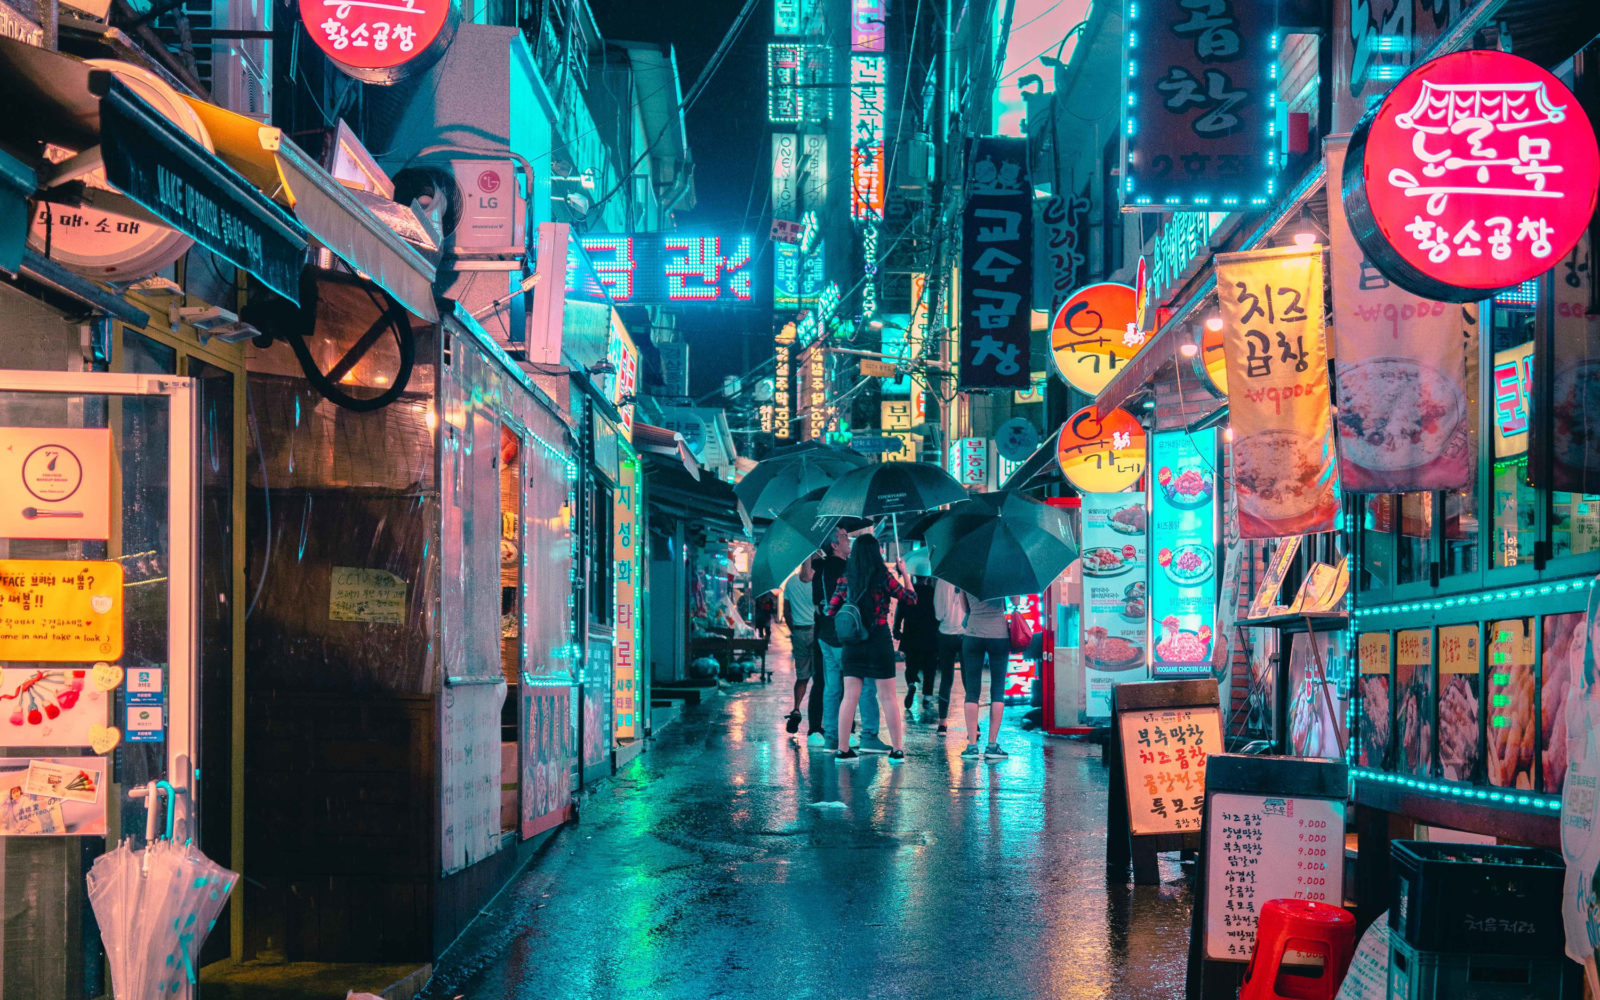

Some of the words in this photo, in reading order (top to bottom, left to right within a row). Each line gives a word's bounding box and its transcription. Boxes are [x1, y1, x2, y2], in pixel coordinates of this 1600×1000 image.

[320, 17, 417, 51] 황소곱창
[157, 163, 184, 215] MAKE
[479, 196, 499, 209] LG
[1405, 215, 1555, 264] 황소곱창
[971, 208, 1023, 376] 고수곱창
[1235, 281, 1308, 325] 치즈
[1244, 330, 1309, 378] 곱창
[966, 440, 985, 481] 부동산
[617, 485, 633, 586] 지성화
[0, 576, 25, 587] FACE
[53, 633, 71, 641] take
[84, 634, 100, 642] look
[616, 603, 633, 668] 타로
[1179, 665, 1199, 673] CHICKEN
[616, 678, 633, 692] 사주
[616, 697, 633, 710] 타로
[1137, 723, 1205, 747] 부추막창
[1222, 811, 1262, 827] 치즈곱창
[1223, 827, 1262, 841] 양념막창
[1223, 841, 1262, 856] 부추막창
[1228, 856, 1258, 868] 닭갈비
[1225, 870, 1257, 884] 삼겹살
[1464, 914, 1537, 935] 처음처럼
